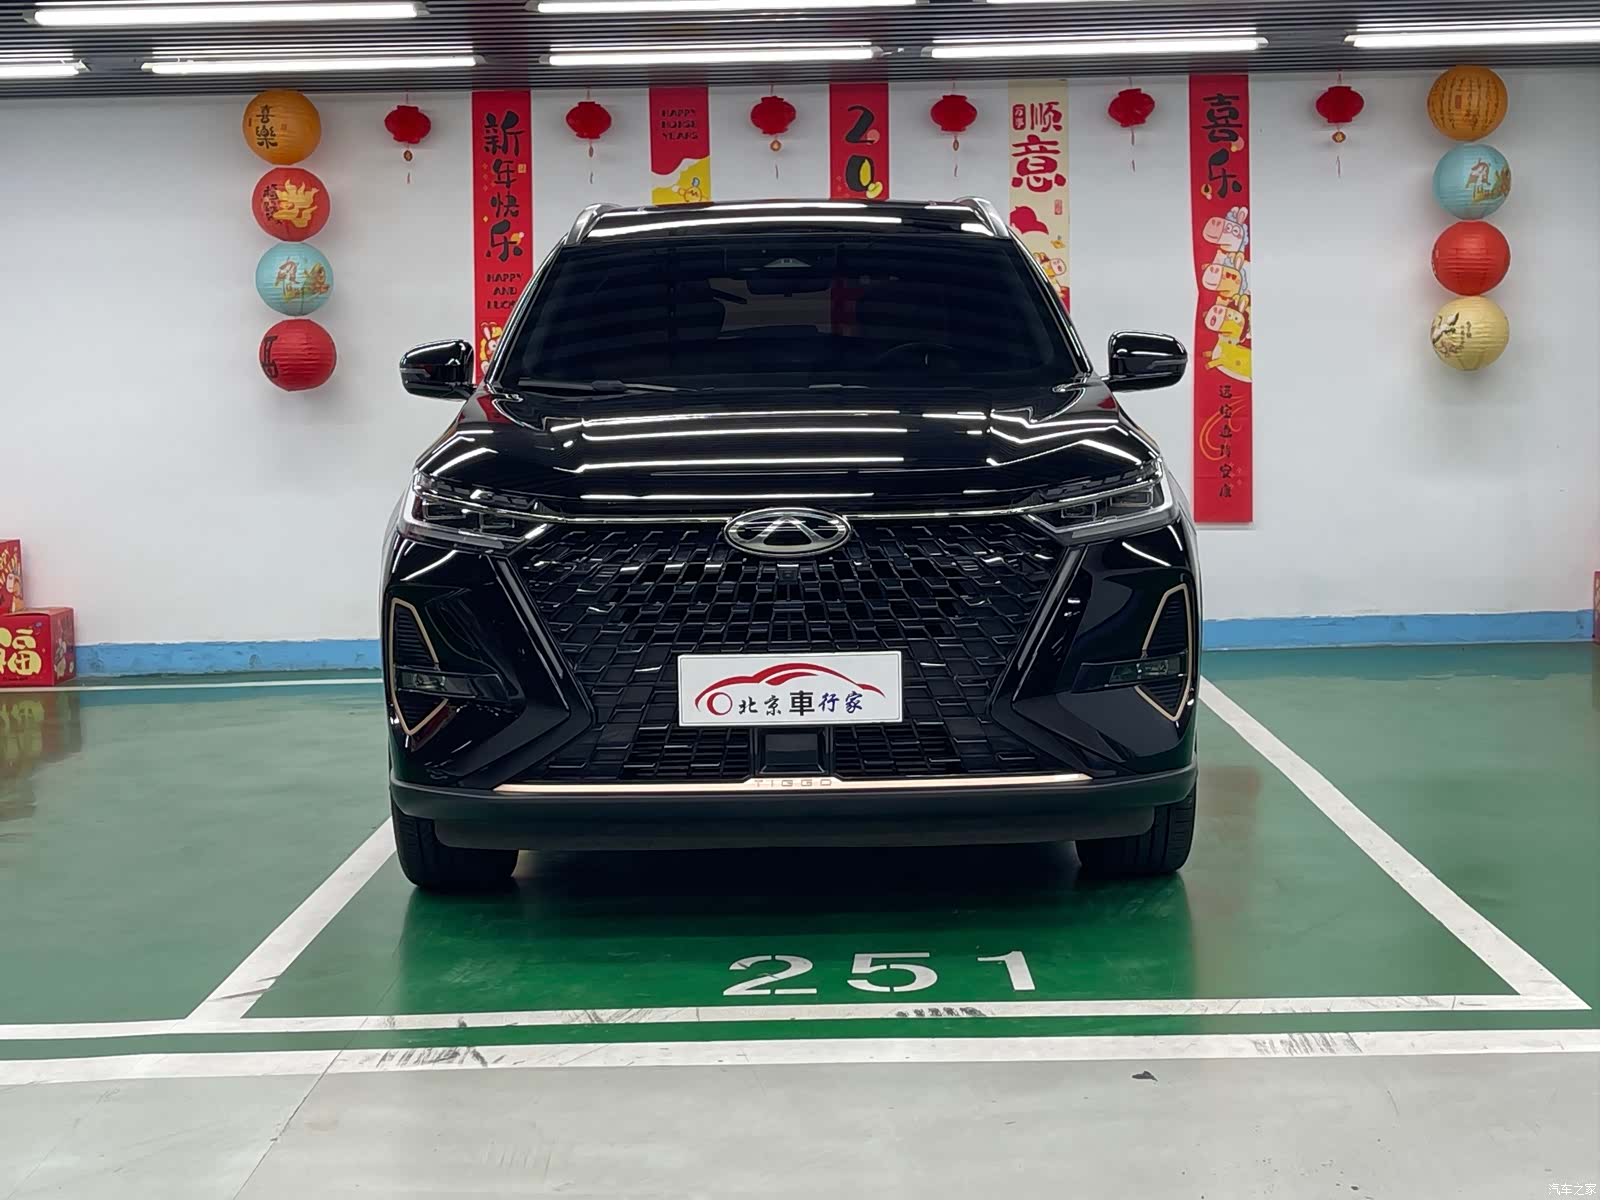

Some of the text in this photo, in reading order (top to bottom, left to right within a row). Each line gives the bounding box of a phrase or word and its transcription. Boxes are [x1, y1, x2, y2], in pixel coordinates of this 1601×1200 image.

[1201, 93, 1242, 198] 喜乐
[484, 110, 525, 262] 新年快乐
[486, 273, 523, 282] HAPPY
[493, 287, 517, 295] AND
[486, 300, 516, 309] LUCK
[754, 779, 832, 787] TIGGO
[723, 950, 1035, 996] 251
